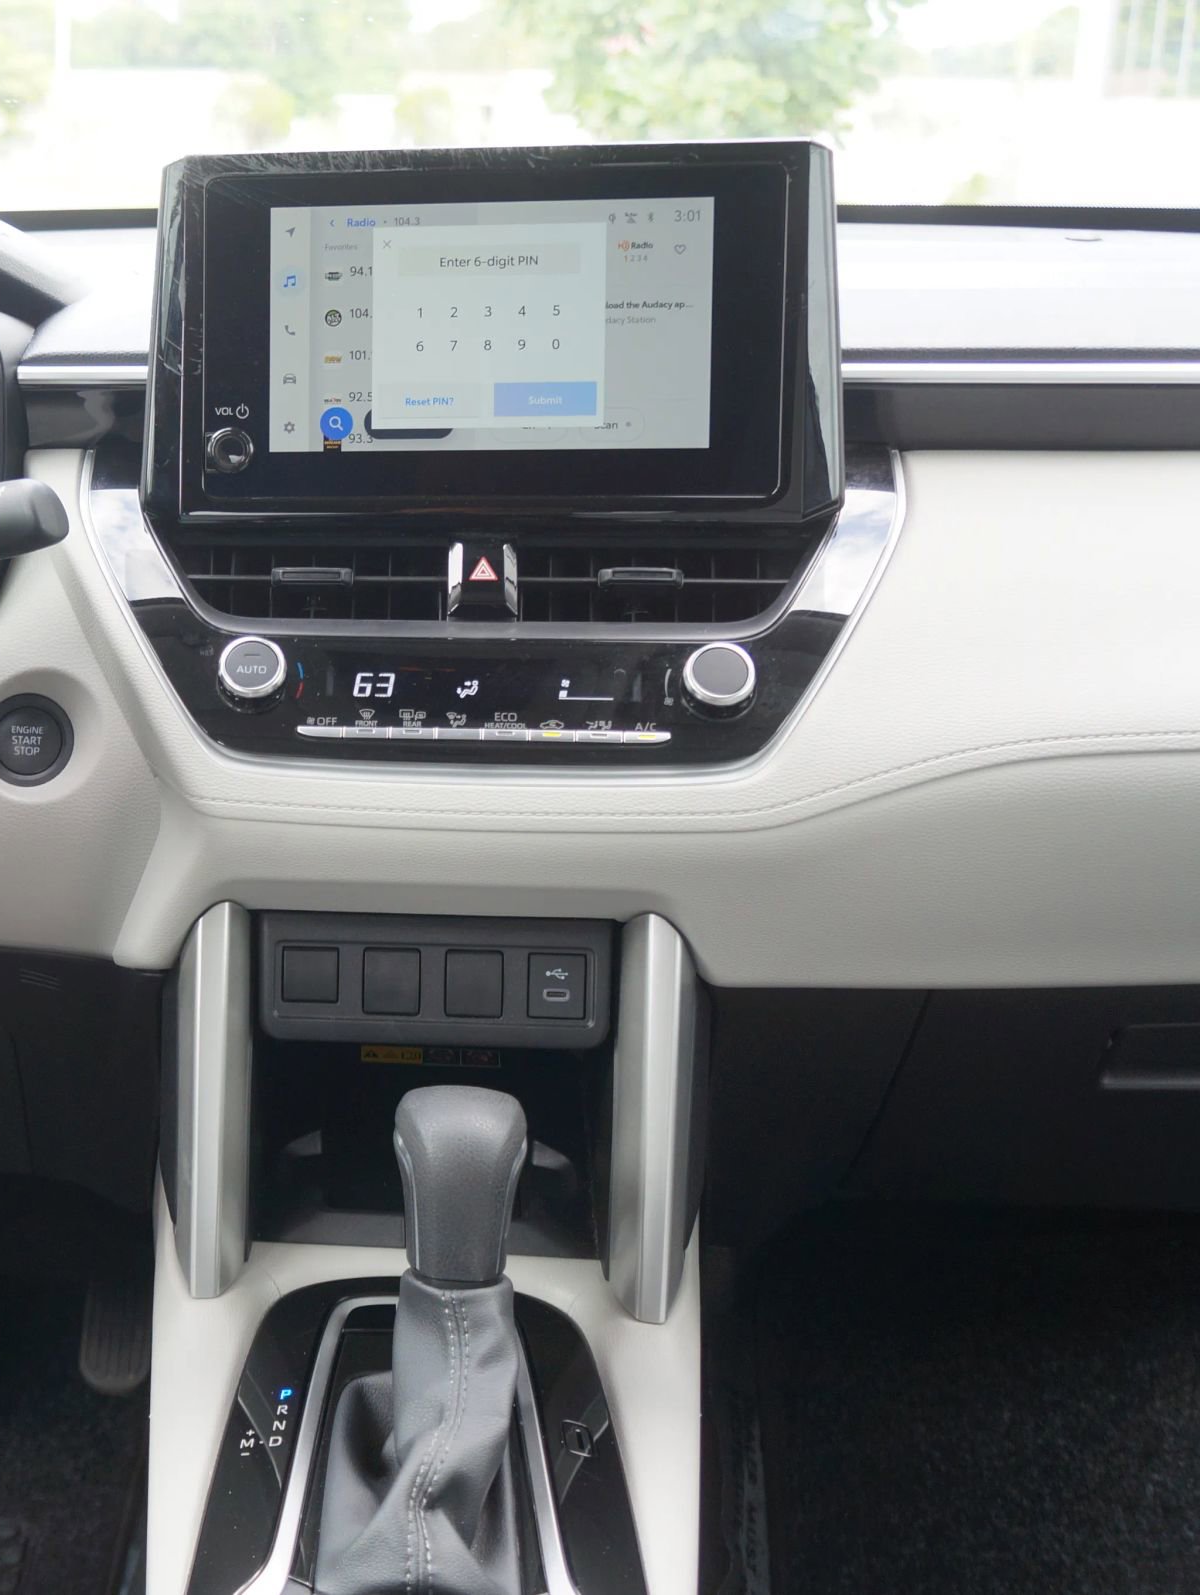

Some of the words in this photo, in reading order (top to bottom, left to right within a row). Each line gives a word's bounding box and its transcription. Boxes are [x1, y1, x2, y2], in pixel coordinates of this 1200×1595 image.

[674, 209, 701, 223] 3:01
[347, 217, 376, 228] Radio
[394, 217, 421, 226] 104.3
[324, 243, 359, 251] Favorites
[631, 241, 654, 250] Radio
[439, 257, 471, 268] Enter
[473, 256, 515, 269] 6-digit
[518, 255, 539, 266] PIN
[350, 266, 373, 277] 94.1
[626, 301, 640, 309] the
[641, 301, 673, 310] Audacy
[416, 307, 423, 318] 1
[450, 306, 458, 318] 2
[483, 306, 492, 317] 3
[518, 305, 527, 317] 4
[552, 304, 561, 316] 5
[626, 315, 657, 324] Station
[416, 340, 425, 352] 6
[450, 340, 458, 351] 7
[483, 339, 492, 351] 8
[517, 338, 526, 350] 9
[552, 338, 560, 350] 0
[349, 350, 373, 361] 101.
[348, 391, 373, 402] 92.5
[405, 397, 431, 406] Reset
[432, 396, 455, 406] PIN?
[528, 396, 563, 406] Submit
[214, 406, 234, 416] VOL
[235, 664, 267, 675] AUTO
[352, 672, 396, 698] 63
[316, 716, 338, 726] OFF
[494, 712, 518, 722] ECO
[355, 720, 379, 728] FRONT
[403, 720, 422, 728] REAR
[484, 722, 527, 730] HEAT/COOL
[634, 722, 657, 732] A/C
[11, 725, 44, 735] ENGINE
[11, 735, 42, 745] START
[13, 746, 41, 756] STOP
[280, 1389, 292, 1400] P
[276, 1405, 288, 1416] R
[272, 1420, 286, 1431] N
[240, 1438, 255, 1449] M
[268, 1436, 282, 1447] D
